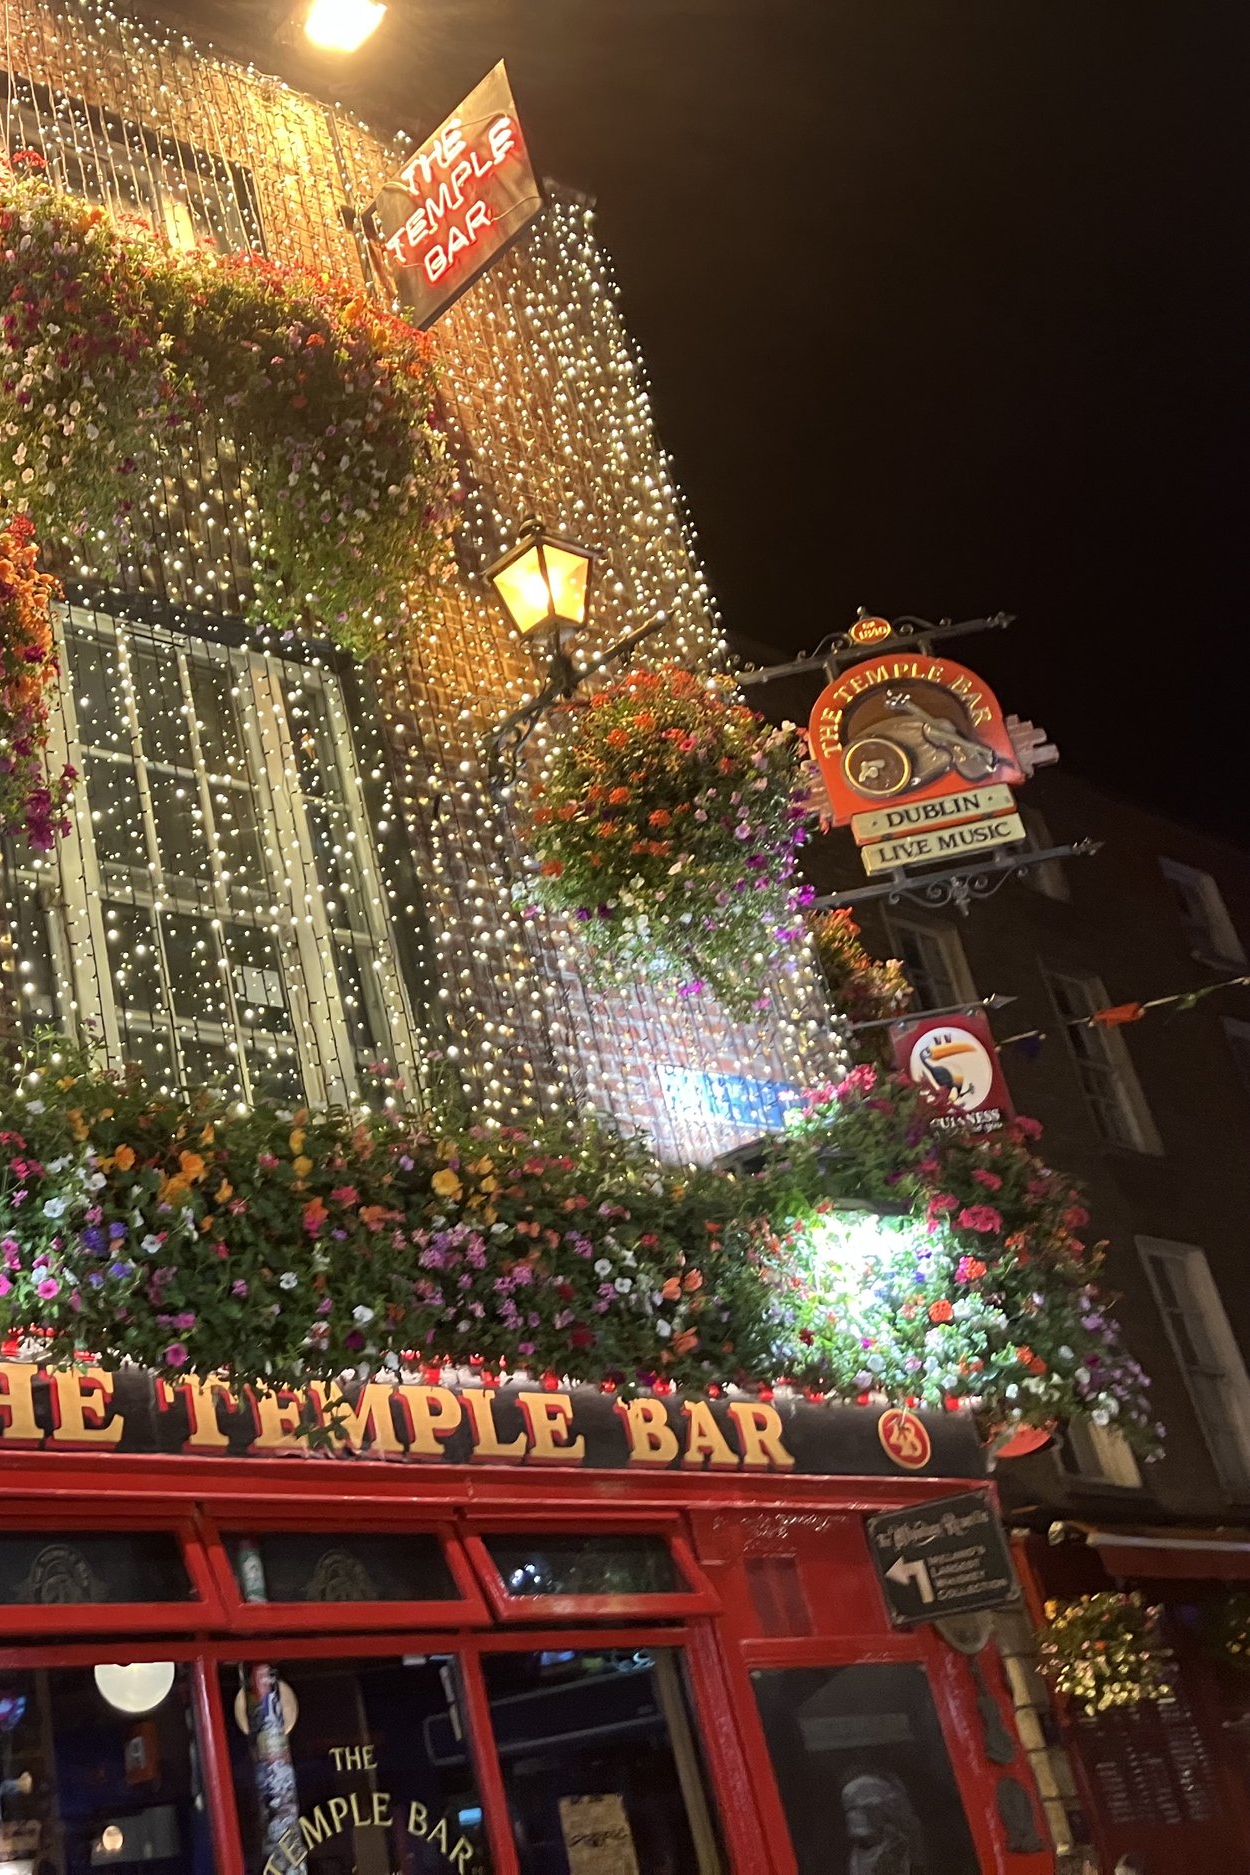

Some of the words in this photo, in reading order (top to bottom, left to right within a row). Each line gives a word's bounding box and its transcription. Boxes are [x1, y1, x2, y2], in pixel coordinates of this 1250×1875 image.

[386, 116, 516, 263] TEMPLE
[401, 118, 467, 196] THE
[424, 200, 492, 282] BAR
[819, 707, 843, 759] THE
[832, 662, 944, 703] TEMPLE
[948, 675, 992, 728] BAR
[879, 838, 933, 863] LIVE
[938, 822, 1012, 848] MUSIC
[886, 794, 981, 828] DUBLIN
[156, 1374, 586, 1463] TEMPLE
[615, 1396, 796, 1469] BAR
[328, 1744, 378, 1771] THE
[262, 1792, 394, 1875] TEMPLE
[407, 1801, 474, 1875] BAR
